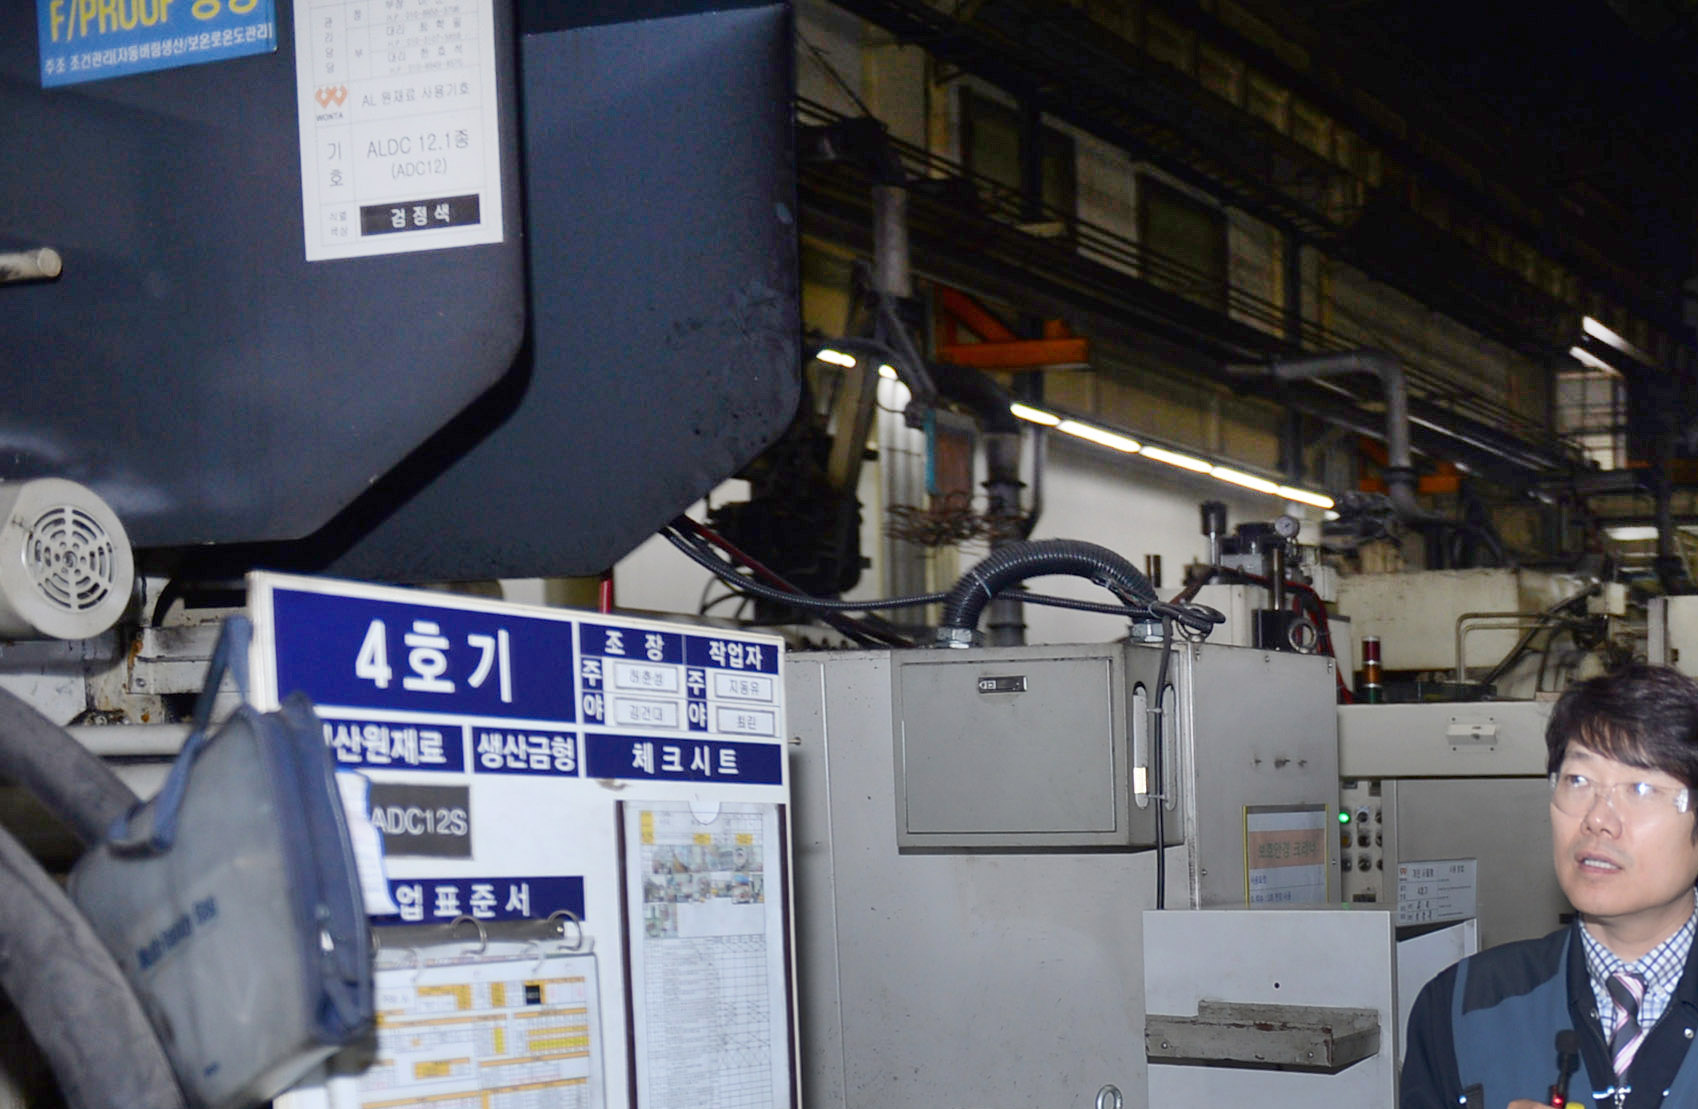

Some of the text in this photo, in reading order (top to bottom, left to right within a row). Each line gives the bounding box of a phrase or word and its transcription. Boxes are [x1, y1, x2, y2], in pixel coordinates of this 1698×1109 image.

[366, 136, 412, 159] ALDC
[391, 158, 448, 180] (ADC12)
[355, 619, 513, 703] 4호기
[708, 640, 764, 671] 작업자
[477, 732, 576, 772] 생산금형
[632, 741, 739, 777] 체크시트
[371, 806, 468, 836] ADC12S
